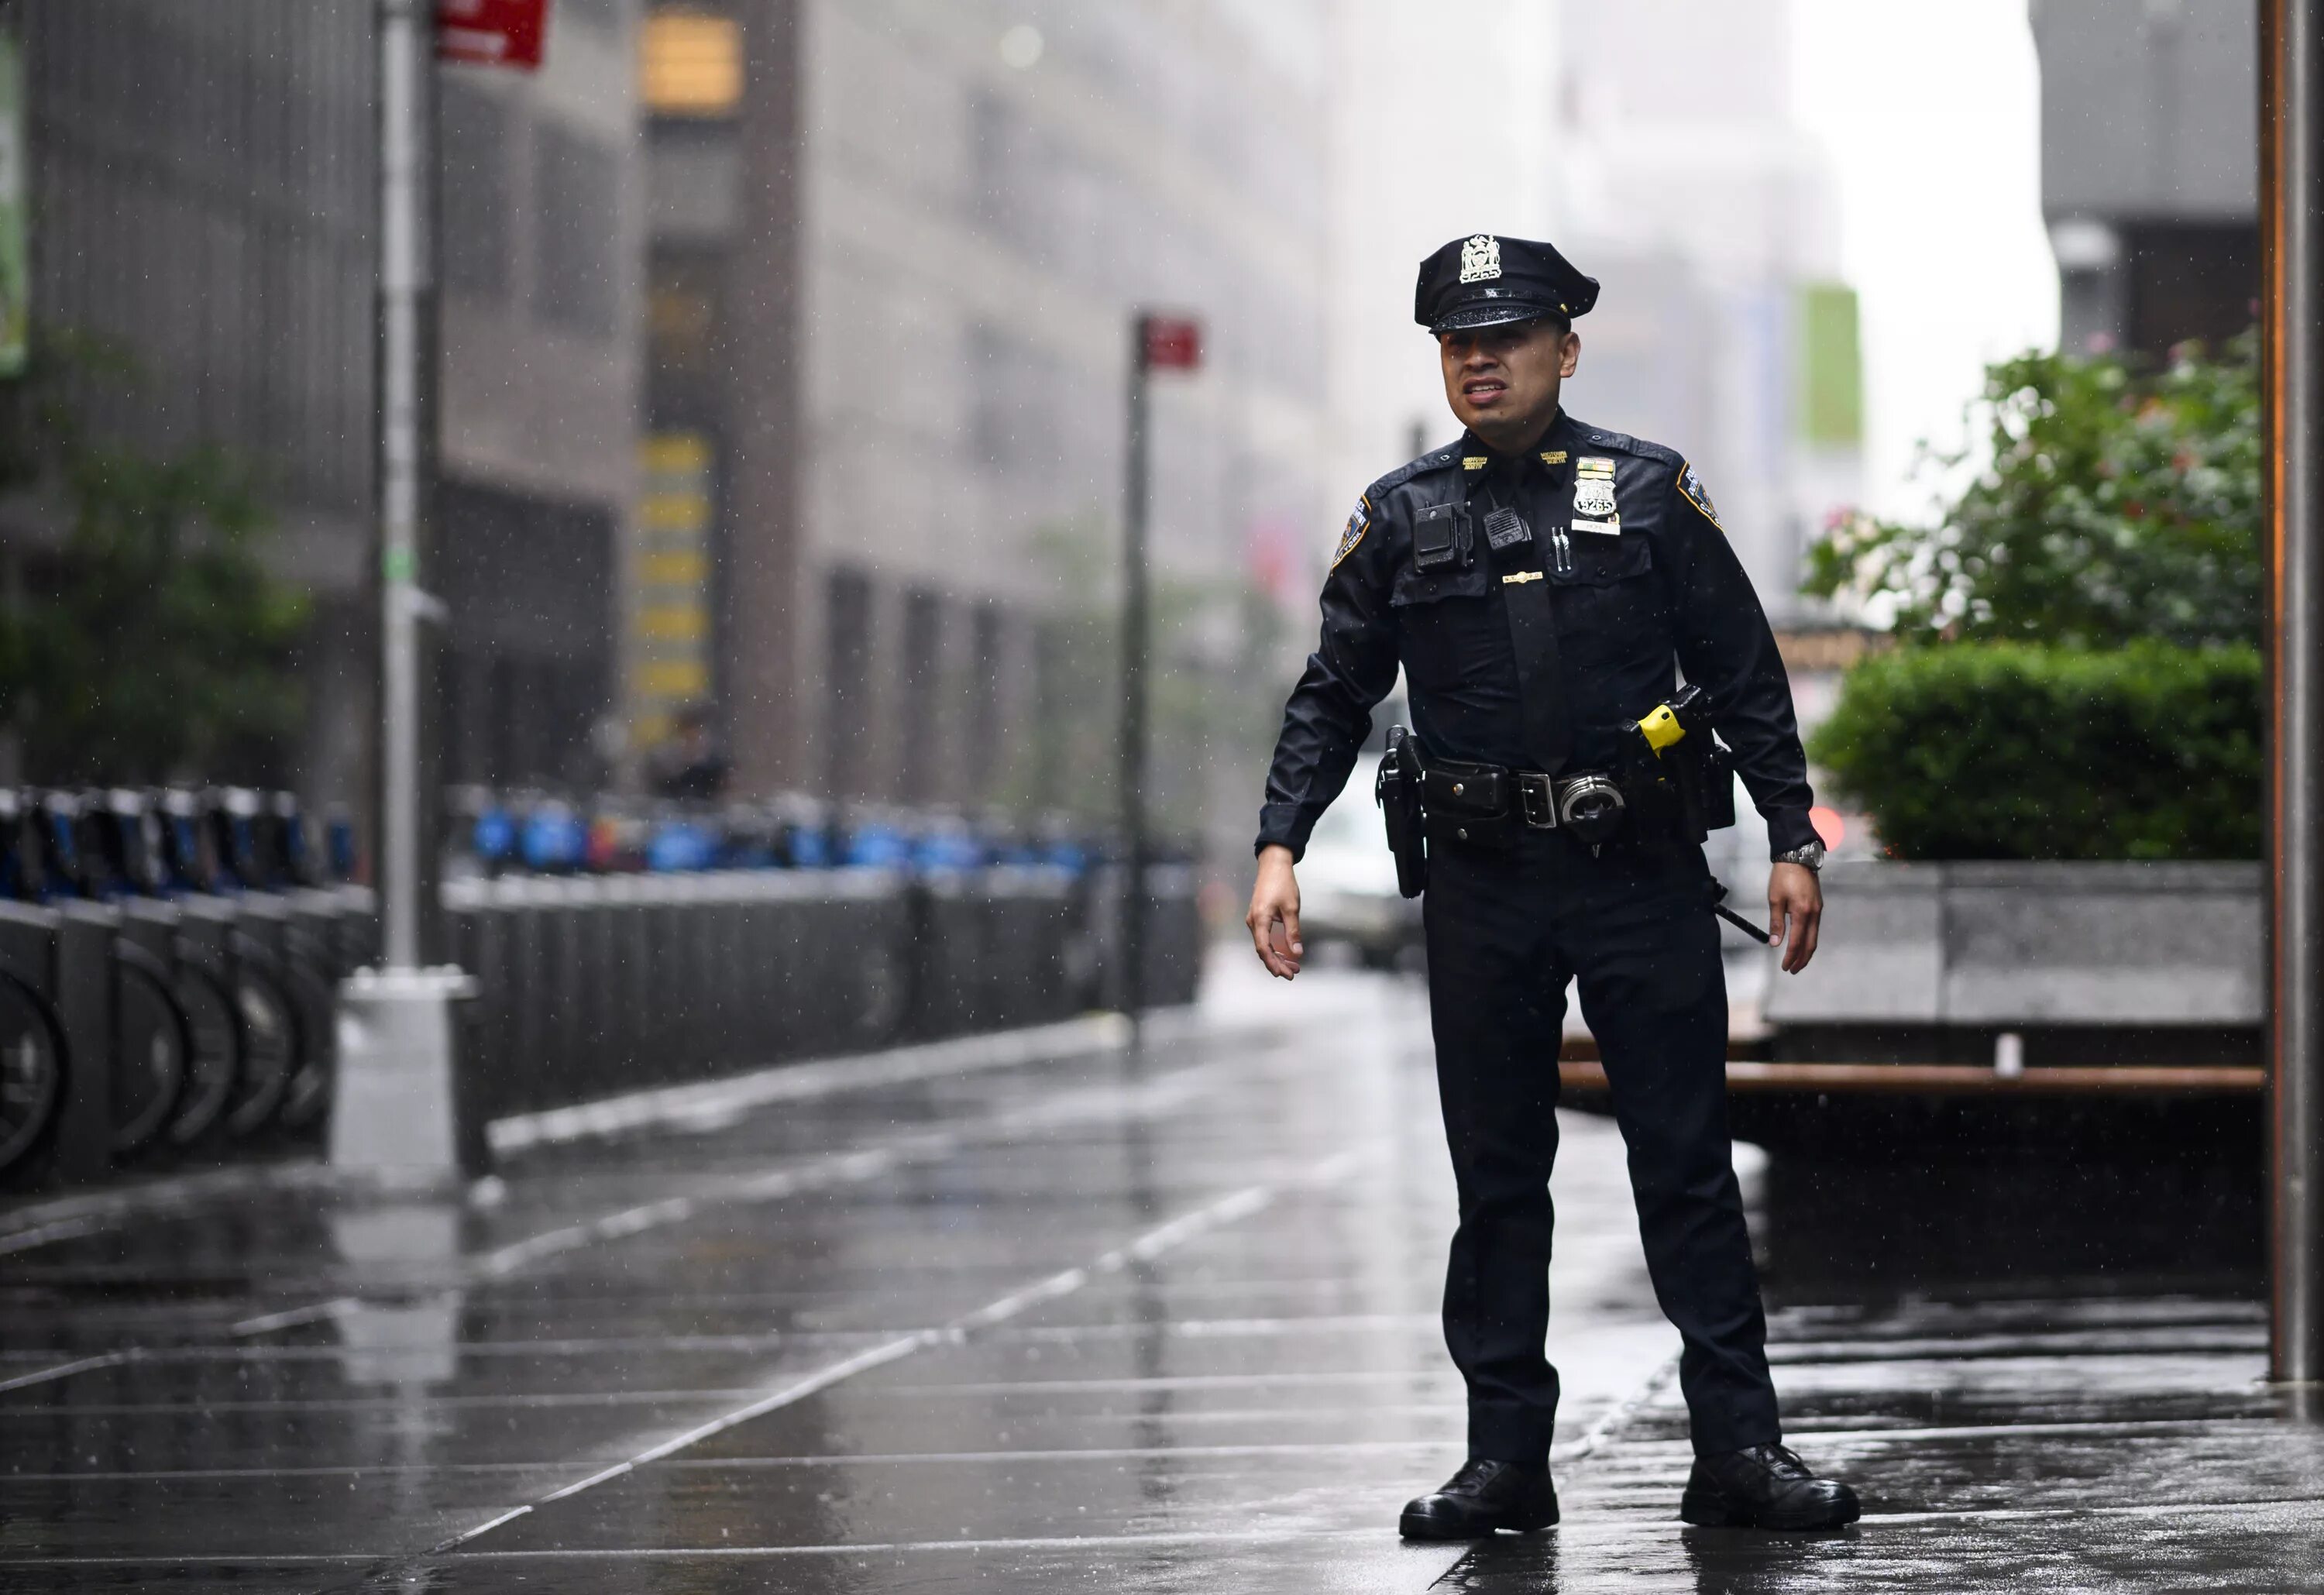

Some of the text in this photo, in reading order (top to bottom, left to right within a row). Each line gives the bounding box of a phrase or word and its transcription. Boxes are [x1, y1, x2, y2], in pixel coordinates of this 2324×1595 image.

[1463, 269, 1499, 282] 9265
[1581, 498, 1611, 511] 9265
[1344, 531, 1361, 551] YORK
